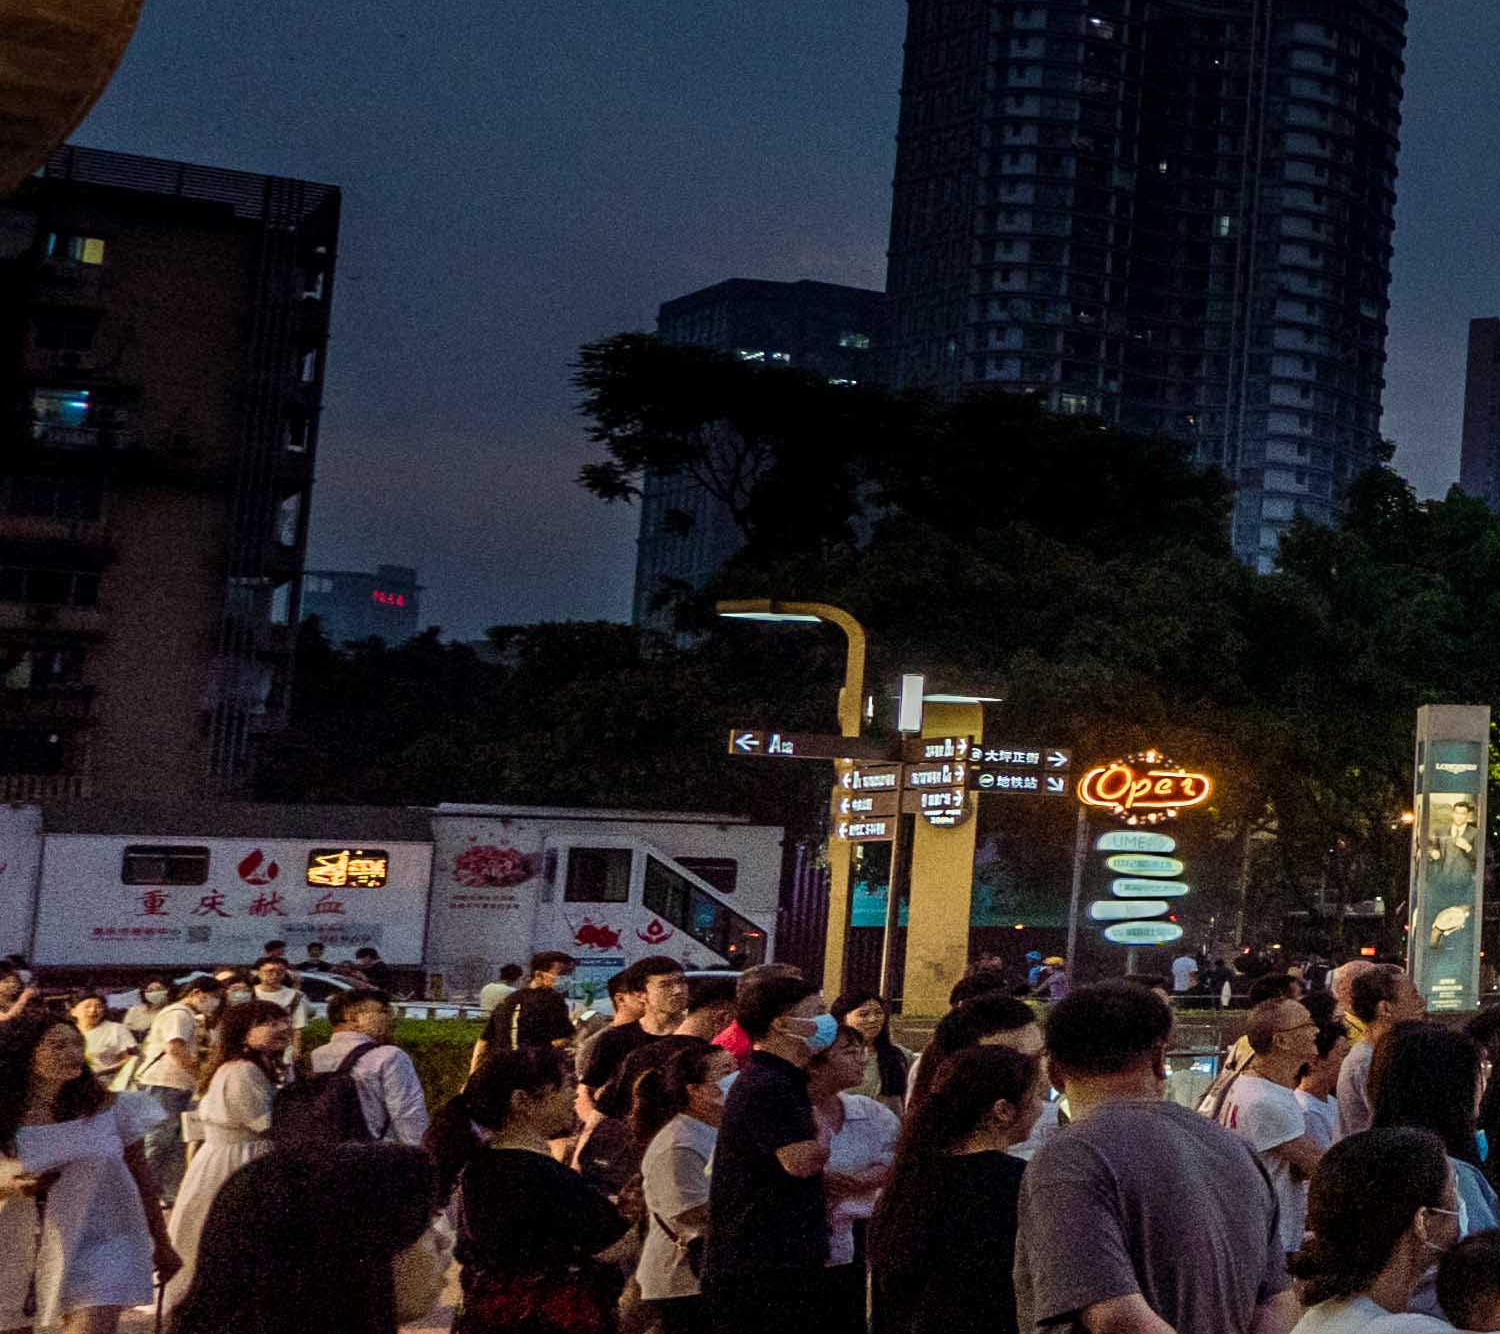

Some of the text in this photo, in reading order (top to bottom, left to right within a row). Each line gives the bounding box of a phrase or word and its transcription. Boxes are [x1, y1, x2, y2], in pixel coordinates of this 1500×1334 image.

[984, 749, 1040, 767] 大坪正街
[997, 775, 1039, 791] 地铁站
[135, 888, 346, 918] 重庆献血
